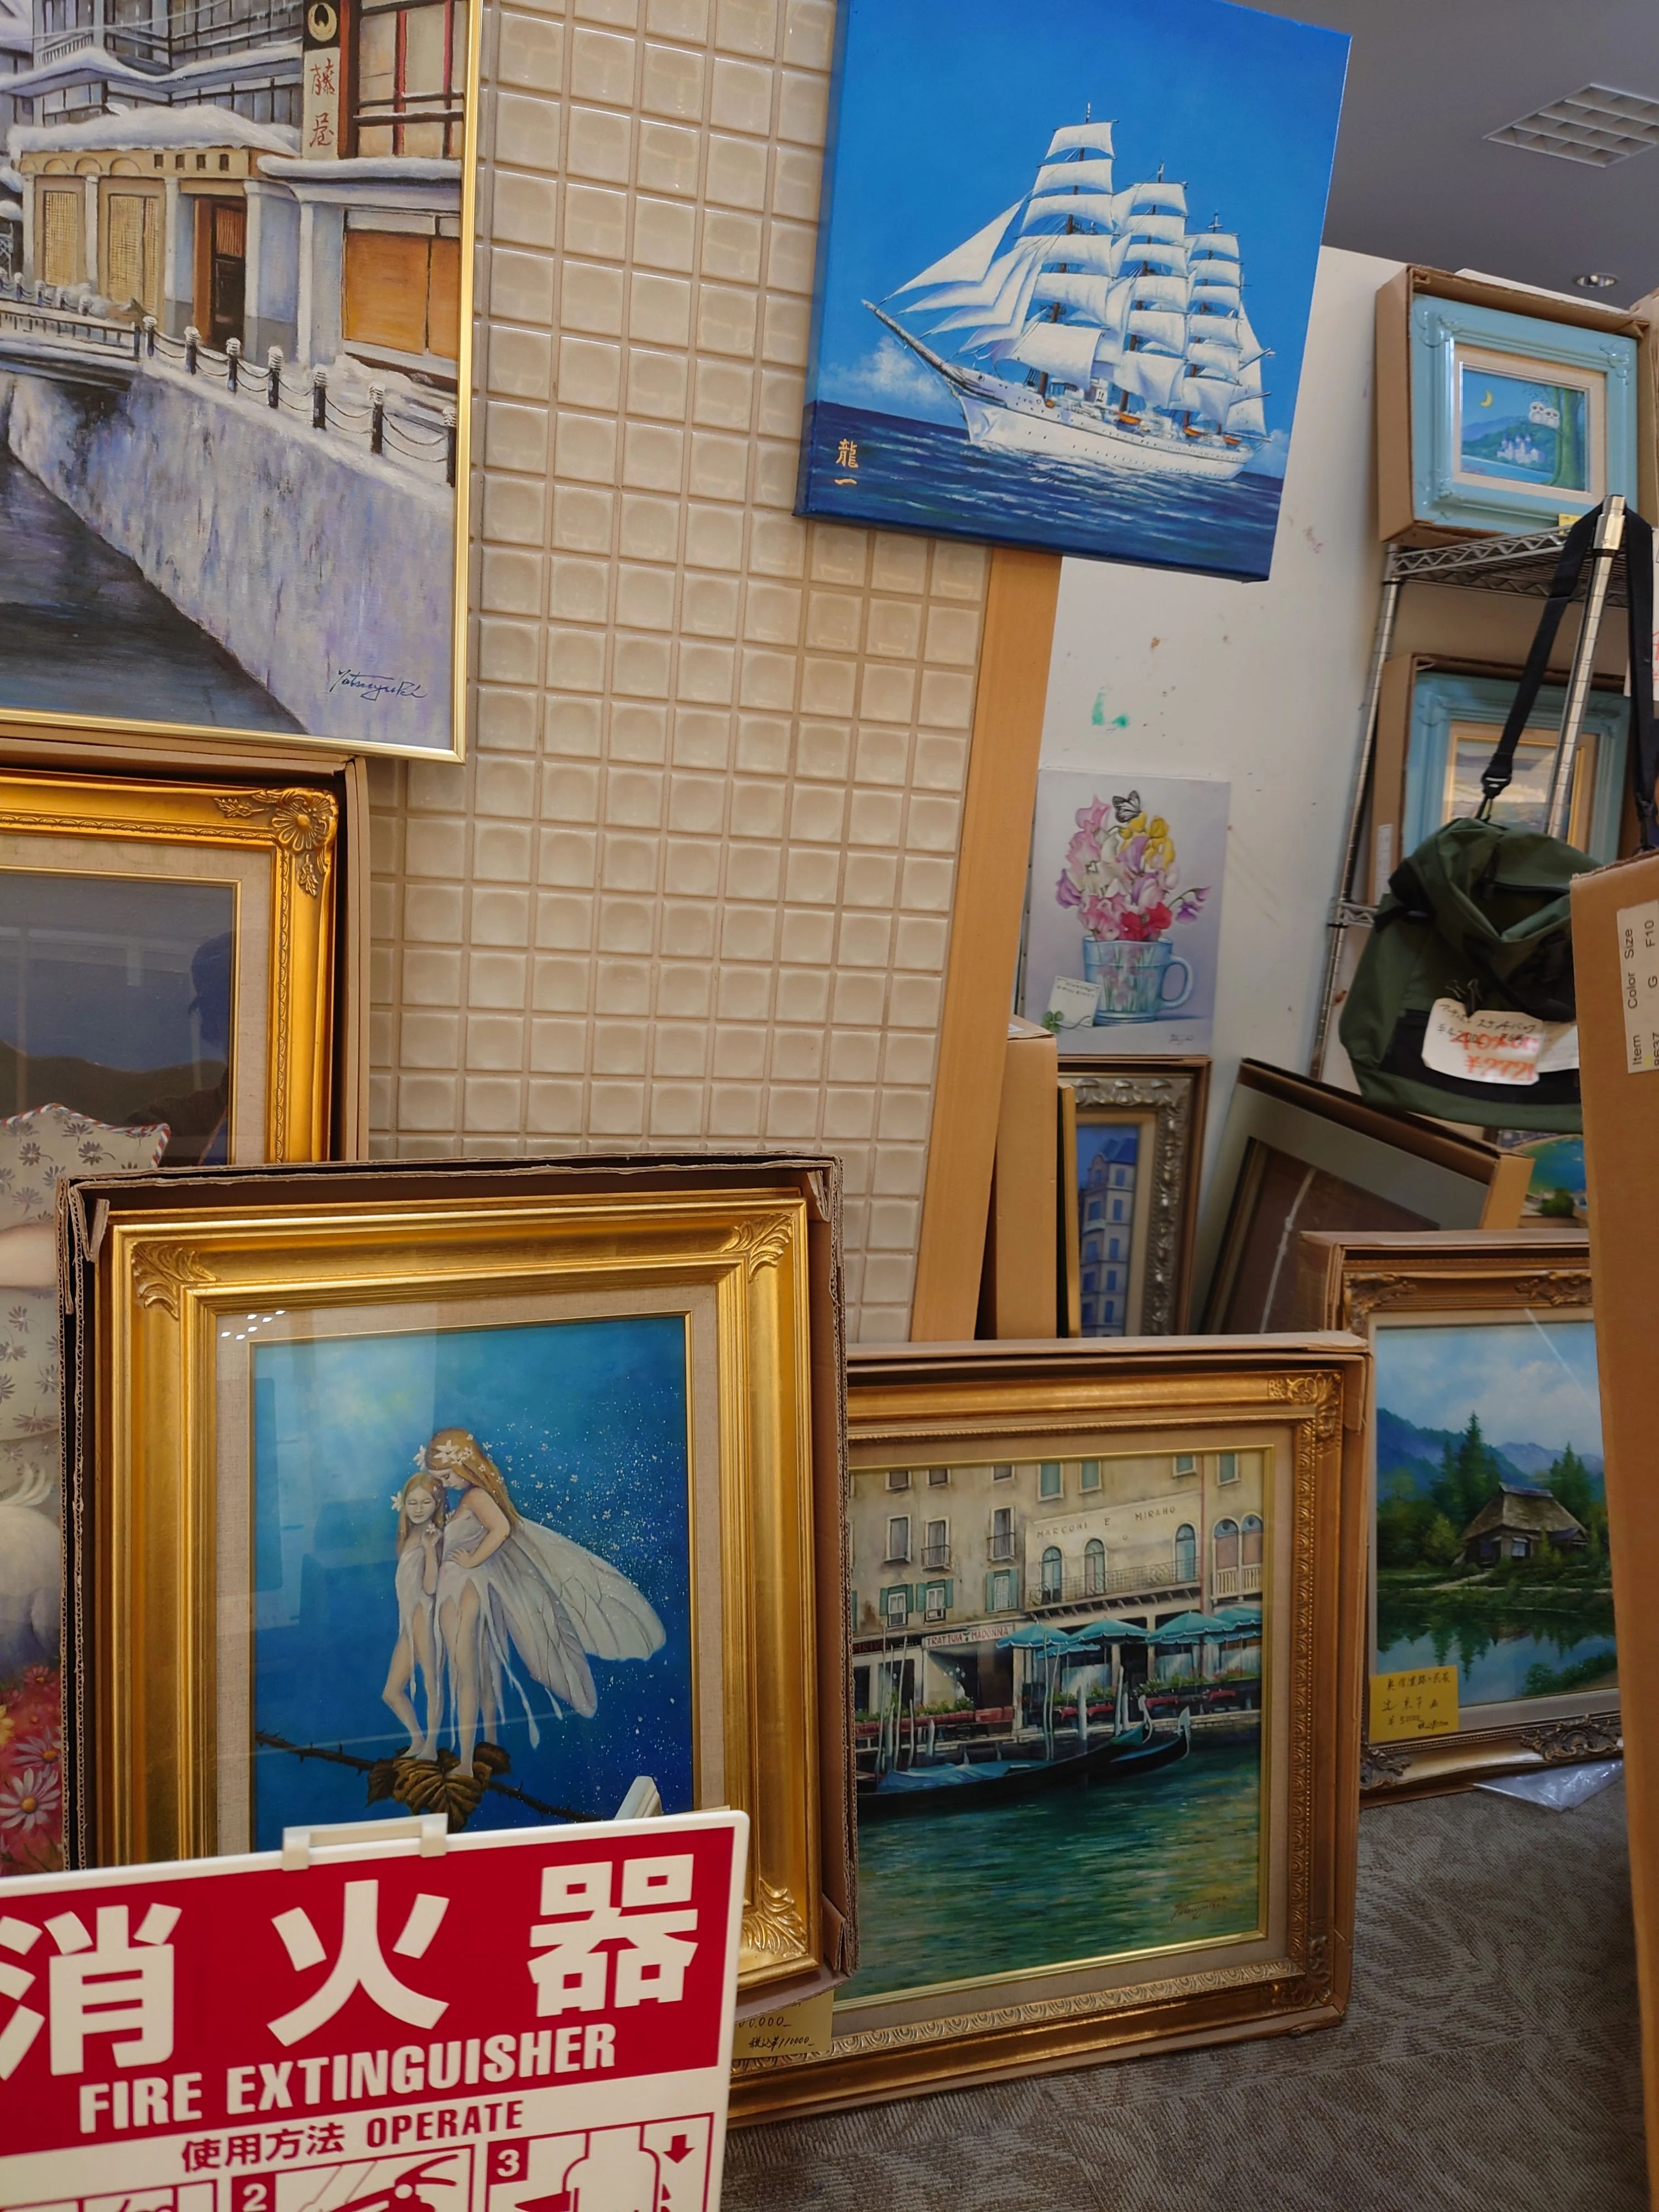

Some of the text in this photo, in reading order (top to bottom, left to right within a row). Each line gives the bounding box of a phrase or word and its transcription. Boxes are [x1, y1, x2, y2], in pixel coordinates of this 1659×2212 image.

[834, 438, 859, 484] 龍一
[1645, 920, 1655, 948] F10
[1624, 928, 1642, 1065] Item Color Size
[1647, 975, 1658, 988] G
[1036, 1506, 1176, 1538] MARCONI E MIRANO
[971, 1627, 1008, 1640] MADONNA
[0, 1854, 699, 2080] 消火器
[80, 2023, 616, 2133] FIRE EXTINGUISHER
[181, 2100, 523, 2173] 使用方法 OPERATE
[497, 2148, 520, 2177] 3
[242, 2183, 267, 2211] 2
